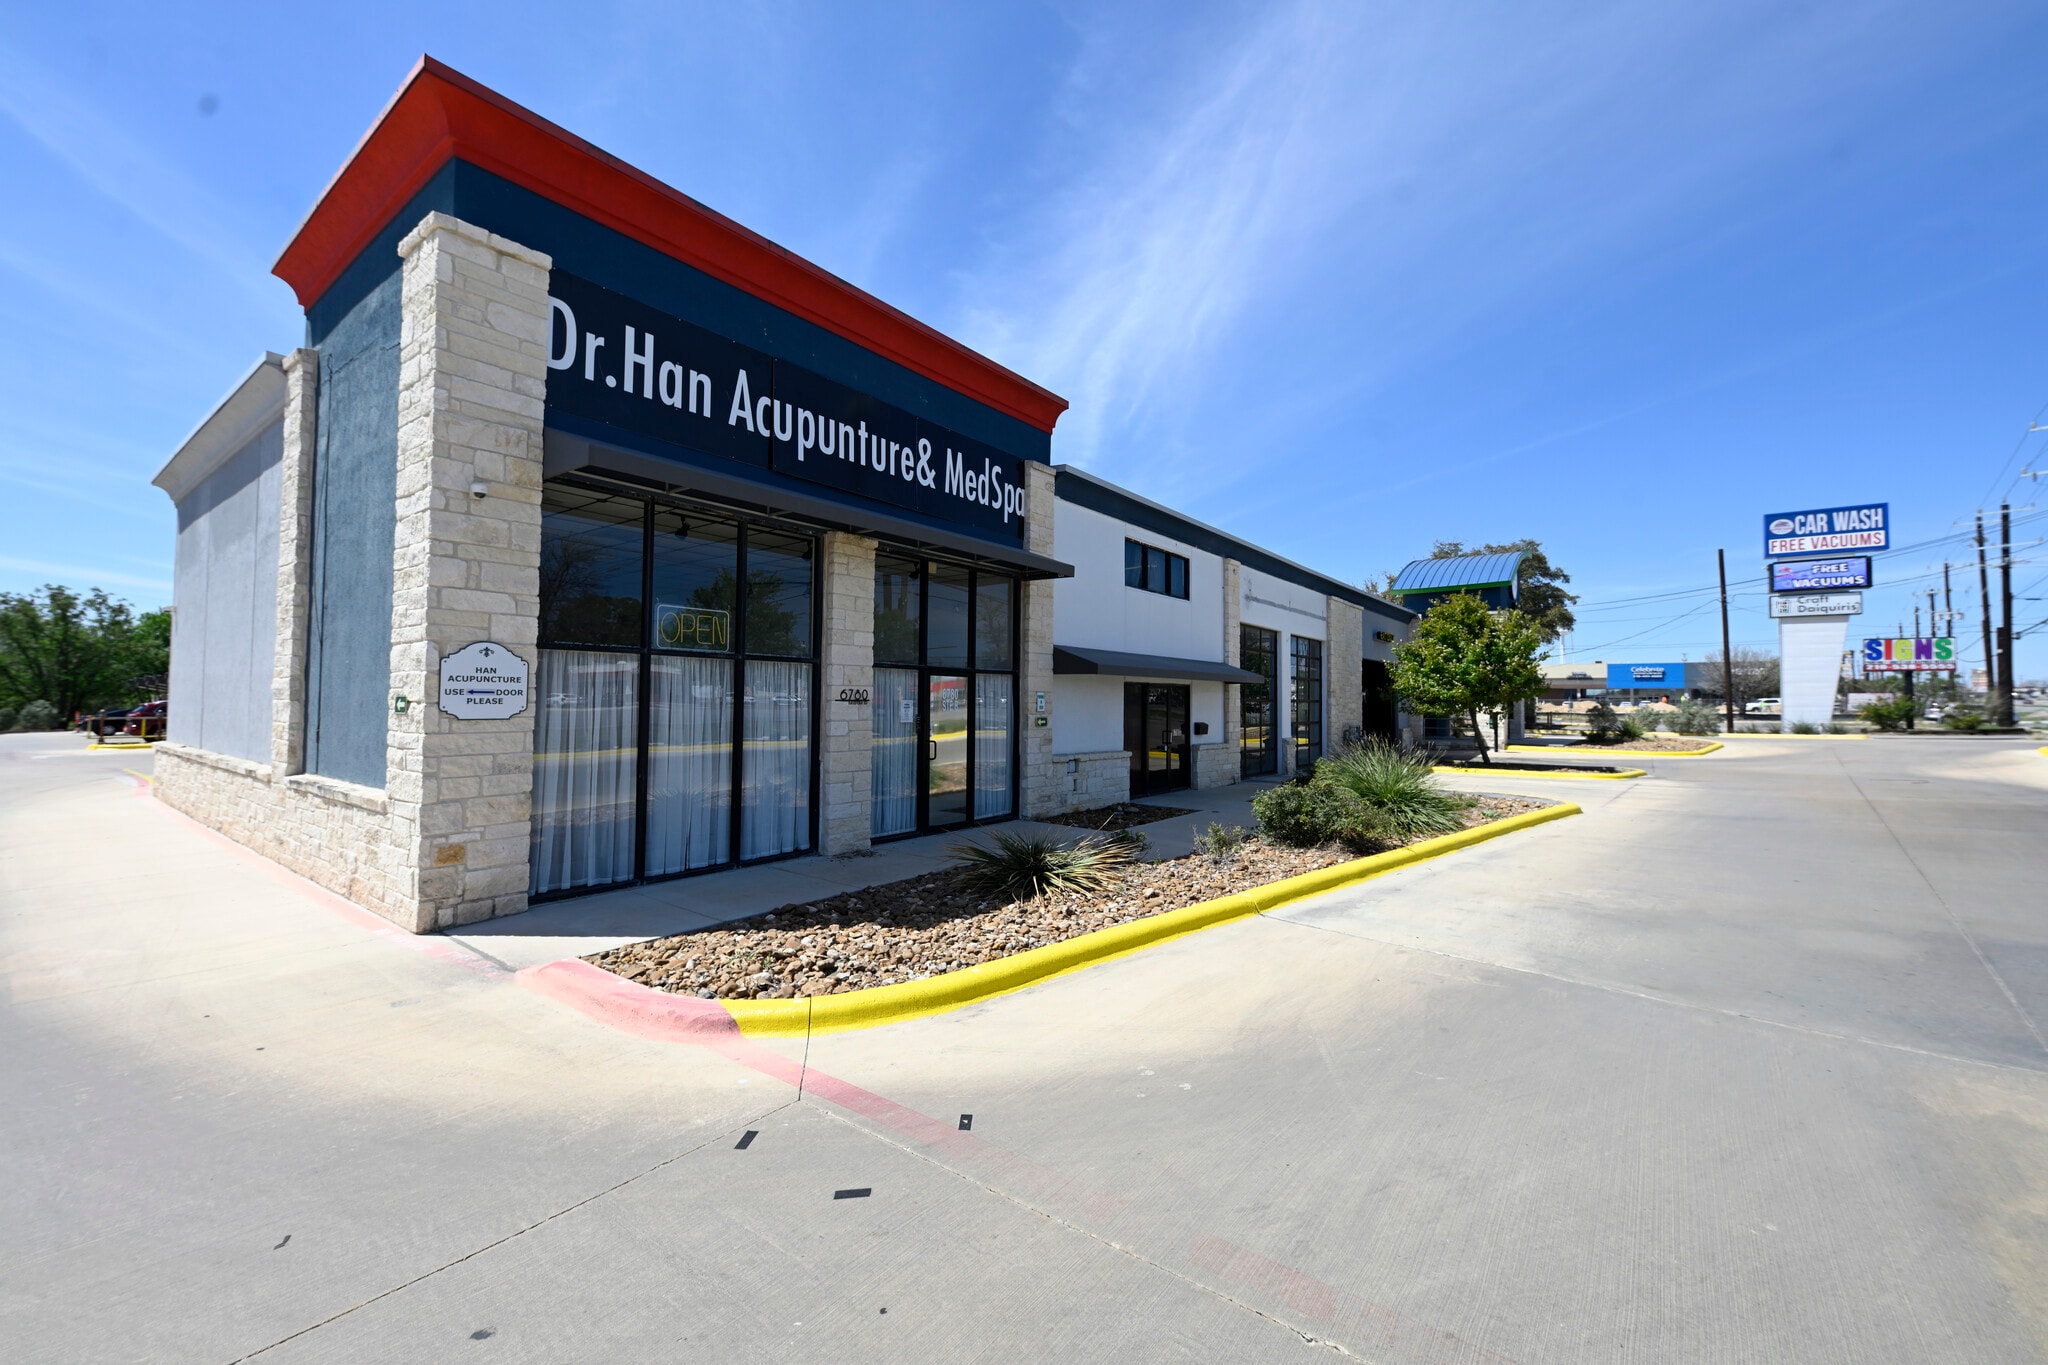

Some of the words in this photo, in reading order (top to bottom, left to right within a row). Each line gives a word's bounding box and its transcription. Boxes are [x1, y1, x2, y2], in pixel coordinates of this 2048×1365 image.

[944, 447, 1025, 523] MedSpa
[1794, 513, 1828, 535] CAR
[1832, 508, 1884, 532] WASH
[1770, 538, 1806, 552] FREE
[1810, 532, 1882, 549] VACUUMS
[1811, 563, 1849, 574] FREE
[1791, 575, 1865, 588] VACUUMS
[1797, 595, 1829, 604] Craft
[660, 611, 727, 645] OPEN
[1866, 637, 1953, 661] SIGNS
[447, 675, 522, 683] ACUPUNCTURE
[942, 688, 959, 700] 6780
